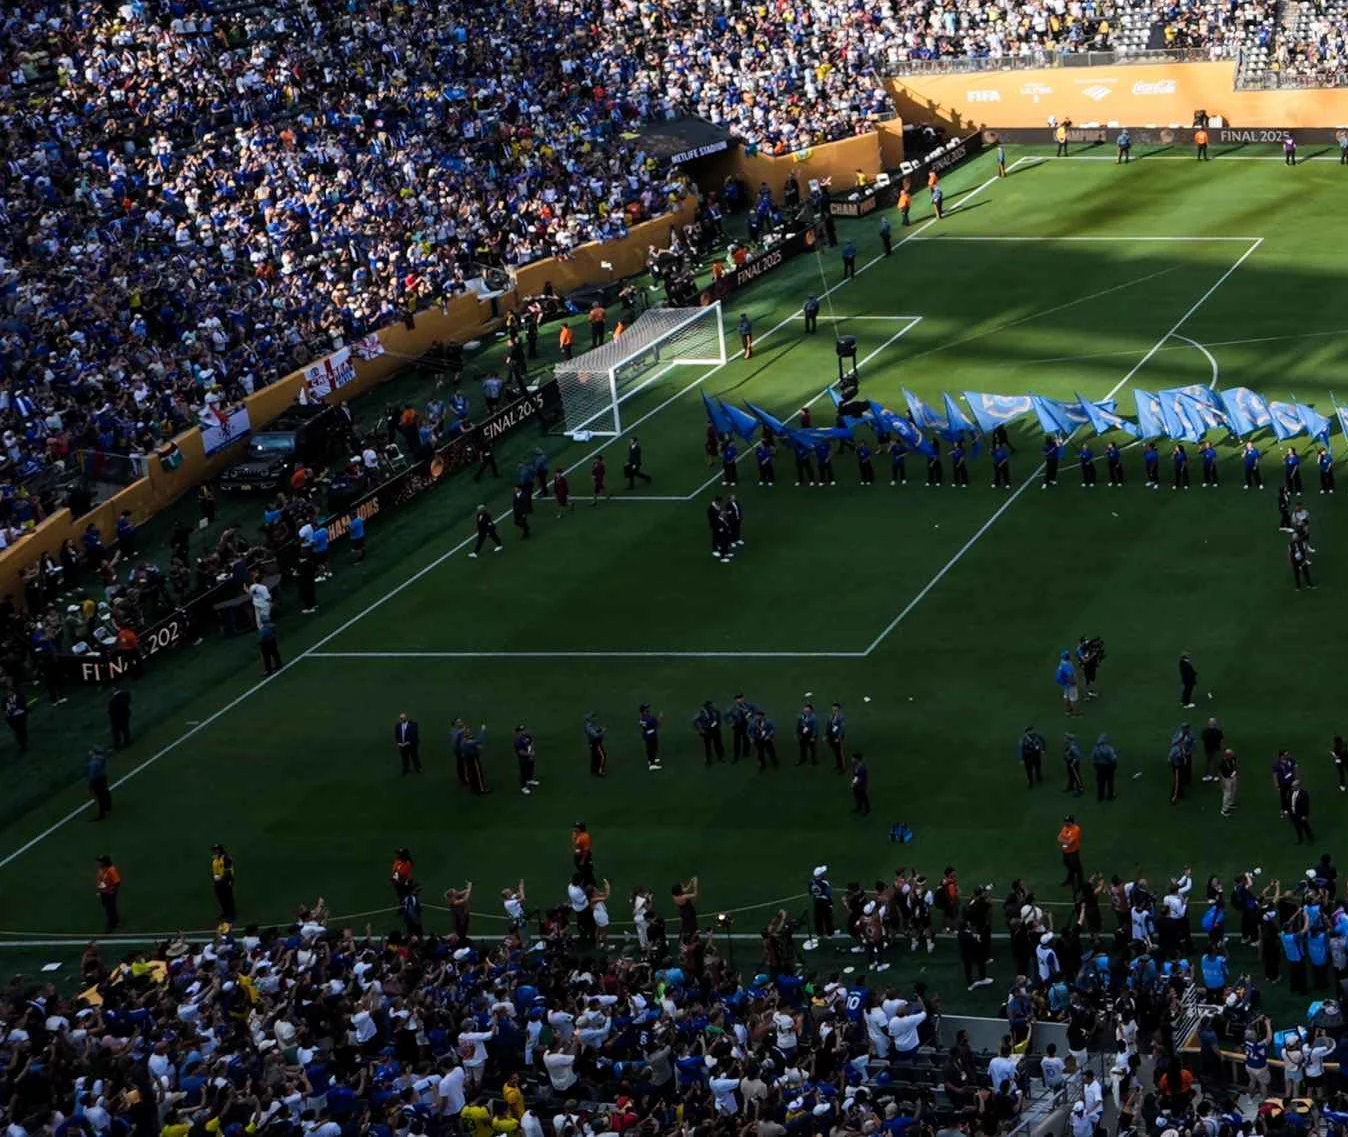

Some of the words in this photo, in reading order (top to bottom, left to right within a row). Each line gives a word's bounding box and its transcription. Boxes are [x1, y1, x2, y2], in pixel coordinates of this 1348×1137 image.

[1220, 130, 1258, 142] FINAL
[671, 149, 699, 163] METLIFE
[737, 261, 762, 287] FINAL
[761, 250, 782, 271] 2025
[82, 655, 128, 681] FIN
[148, 621, 179, 655] 202
[846, 996, 860, 1010] 10
